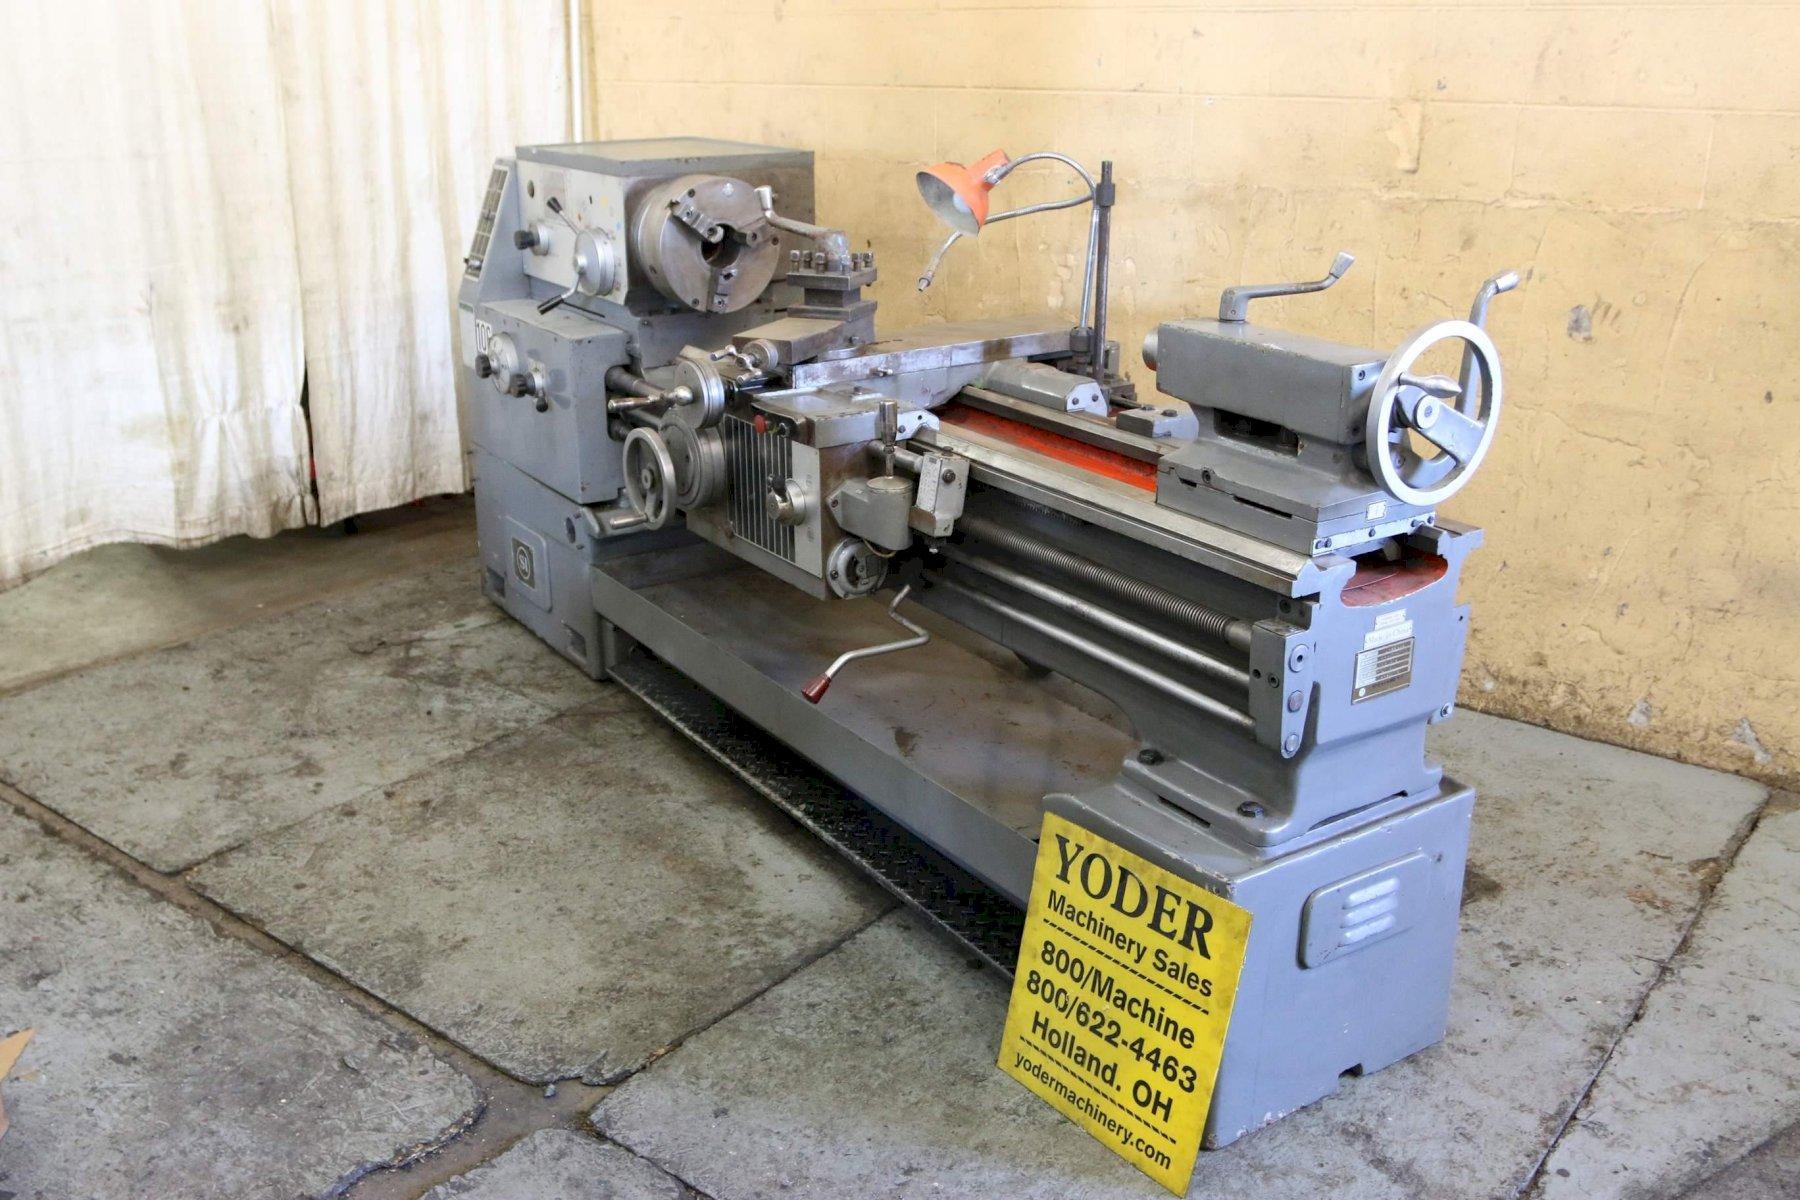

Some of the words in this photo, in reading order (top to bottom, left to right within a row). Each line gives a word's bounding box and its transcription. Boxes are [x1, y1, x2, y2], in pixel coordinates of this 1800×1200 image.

[1048, 889, 1147, 964] Machinery
[1153, 949, 1213, 998] Sales
[1055, 833, 1213, 960] YODER
[1027, 970, 1198, 1094] 800/622-4463
[1041, 940, 1195, 1049] 800/Machine
[1014, 1051, 1172, 1170] yodermachinery.com
[1132, 1080, 1173, 1124] OH
